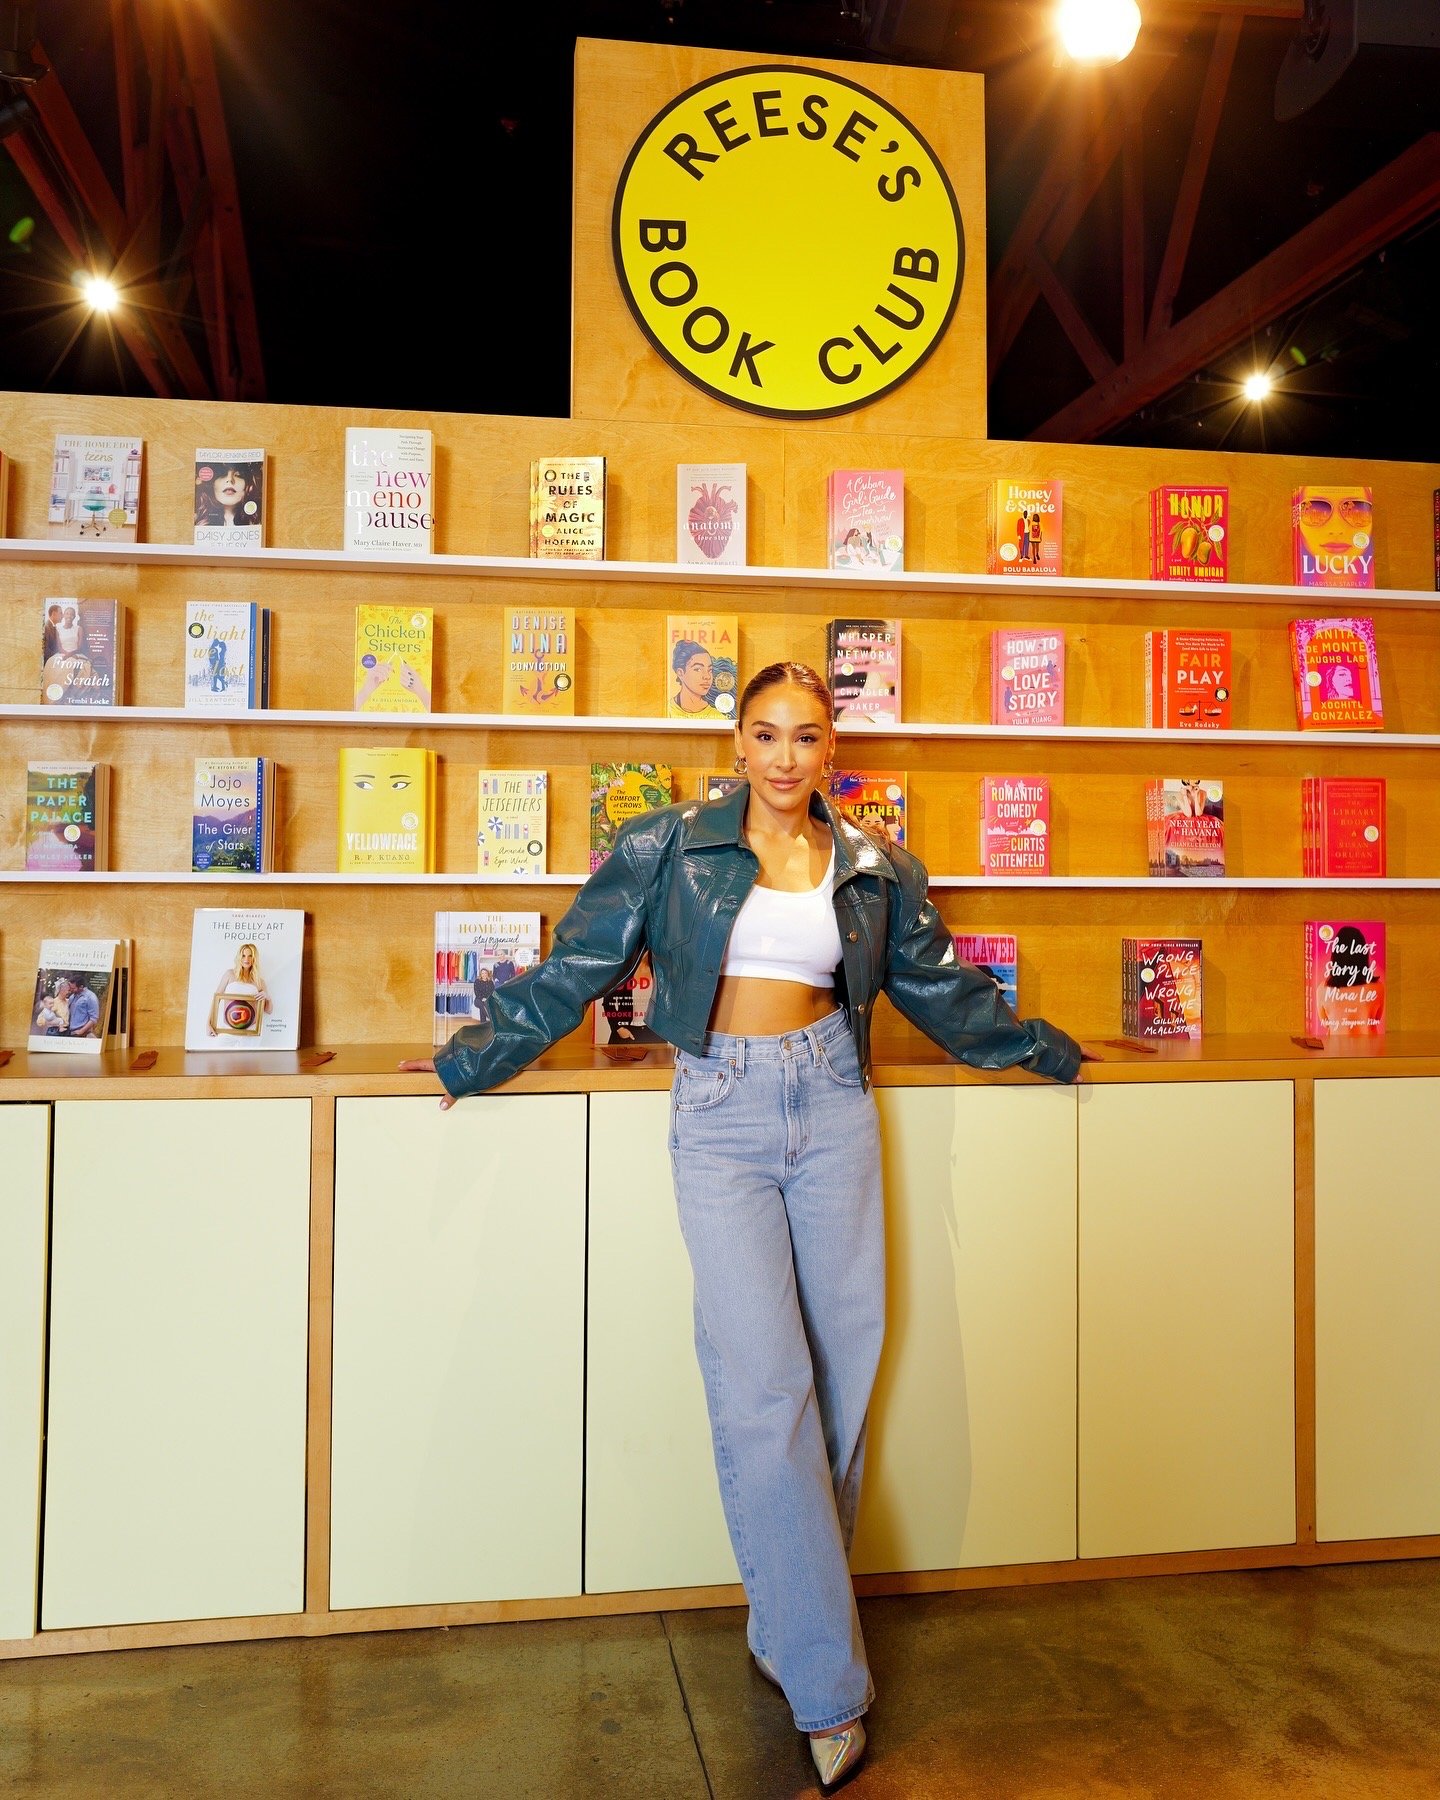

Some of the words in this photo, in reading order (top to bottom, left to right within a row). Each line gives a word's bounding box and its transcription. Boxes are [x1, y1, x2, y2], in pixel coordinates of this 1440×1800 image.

[662, 90, 921, 202] REESE'S
[639, 218, 776, 388] BOOK
[818, 247, 940, 385] CLUB
[84, 451, 113, 463] teens
[350, 440, 393, 467] the
[376, 470, 432, 488] new
[854, 476, 886, 492] Cuban
[548, 486, 593, 495] RULES
[869, 486, 897, 505] Guide
[1008, 486, 1052, 502] Honey
[346, 490, 422, 509] meno
[564, 500, 578, 508] OF
[1170, 494, 1224, 519] HONOR
[1005, 500, 1016, 512] &
[1018, 500, 1056, 517] Spice
[355, 511, 434, 534] pause
[546, 512, 595, 522] MAGIC
[196, 532, 225, 541] DAISY
[226, 530, 260, 541] JONES
[354, 540, 370, 548] Mary
[1169, 566, 1191, 576] THRITY
[1194, 566, 1224, 577] UMRIGAR
[1303, 555, 1372, 574] LUCKY
[195, 609, 215, 621] the
[388, 616, 402, 624] The
[512, 615, 566, 630] DENISE
[207, 625, 246, 642] light
[364, 624, 426, 640] Chicken
[672, 630, 732, 644] FURIA
[838, 632, 892, 643] WHISPER
[1316, 628, 1355, 640] ANITA
[369, 639, 422, 653] Sisters
[511, 633, 567, 655] MINA
[1007, 639, 1036, 655] HOW
[1040, 637, 1058, 651] TO
[1322, 642, 1366, 652] MONTE
[193, 648, 217, 659] we
[837, 650, 894, 660] NETWORK
[1180, 653, 1221, 668] FAIR
[1306, 654, 1342, 664] LAUGHS
[1346, 654, 1370, 664] LAST
[53, 656, 84, 669] From
[510, 662, 566, 672] CONVICTION
[1014, 656, 1039, 670] END
[1042, 654, 1049, 668] A
[213, 664, 245, 677] lost
[1177, 670, 1224, 685] PLAY
[64, 673, 110, 686] Scratch
[1014, 672, 1051, 692] LOVE
[840, 688, 890, 697] CHANDLER
[850, 702, 881, 710] BAKER
[1008, 691, 1058, 711] STORY
[1321, 701, 1364, 710] XOCHITL
[1032, 716, 1052, 724] KUANG
[1313, 711, 1373, 720] GONZALEZ
[47, 778, 78, 789] THE
[210, 774, 242, 792] Jojo
[504, 781, 522, 794] THE
[37, 796, 87, 806] PAPER
[862, 790, 882, 801] L.A.
[992, 786, 1043, 802] ROMANTIC
[201, 794, 250, 812] Moyes
[483, 798, 542, 812] JETSETTERS
[845, 805, 901, 816] WEATHER
[997, 804, 1038, 818] COMEDY
[30, 812, 92, 824] PALACE
[1170, 820, 1194, 828] NEXT
[1196, 820, 1221, 828] YEAR
[198, 824, 218, 835] The
[222, 824, 252, 835] Giver
[1181, 828, 1218, 836] HAVANA
[206, 841, 216, 853] of
[218, 840, 244, 850] Stars
[345, 832, 418, 852] YELLOWFACE
[1011, 838, 1045, 852] CURTIS
[990, 854, 1045, 868] SITTENFELD
[212, 922, 230, 930] THE
[235, 922, 263, 930] BELLY
[266, 922, 284, 930] ART
[459, 924, 497, 934] HOME
[501, 924, 530, 934] EDIT
[224, 932, 271, 940] PROJECT
[956, 936, 1015, 962] UTLAWED
[1324, 936, 1348, 954] The
[1142, 950, 1194, 966] WRONG
[1156, 964, 1198, 979] PLACE
[1324, 961, 1360, 987] Story
[1362, 960, 1376, 984] of
[1144, 984, 1194, 1000] WRONG
[1325, 986, 1358, 1002] Mina
[1360, 988, 1377, 1003] Lee
[1167, 998, 1196, 1014] TIME
[1153, 1016, 1186, 1026] GILLIAN
